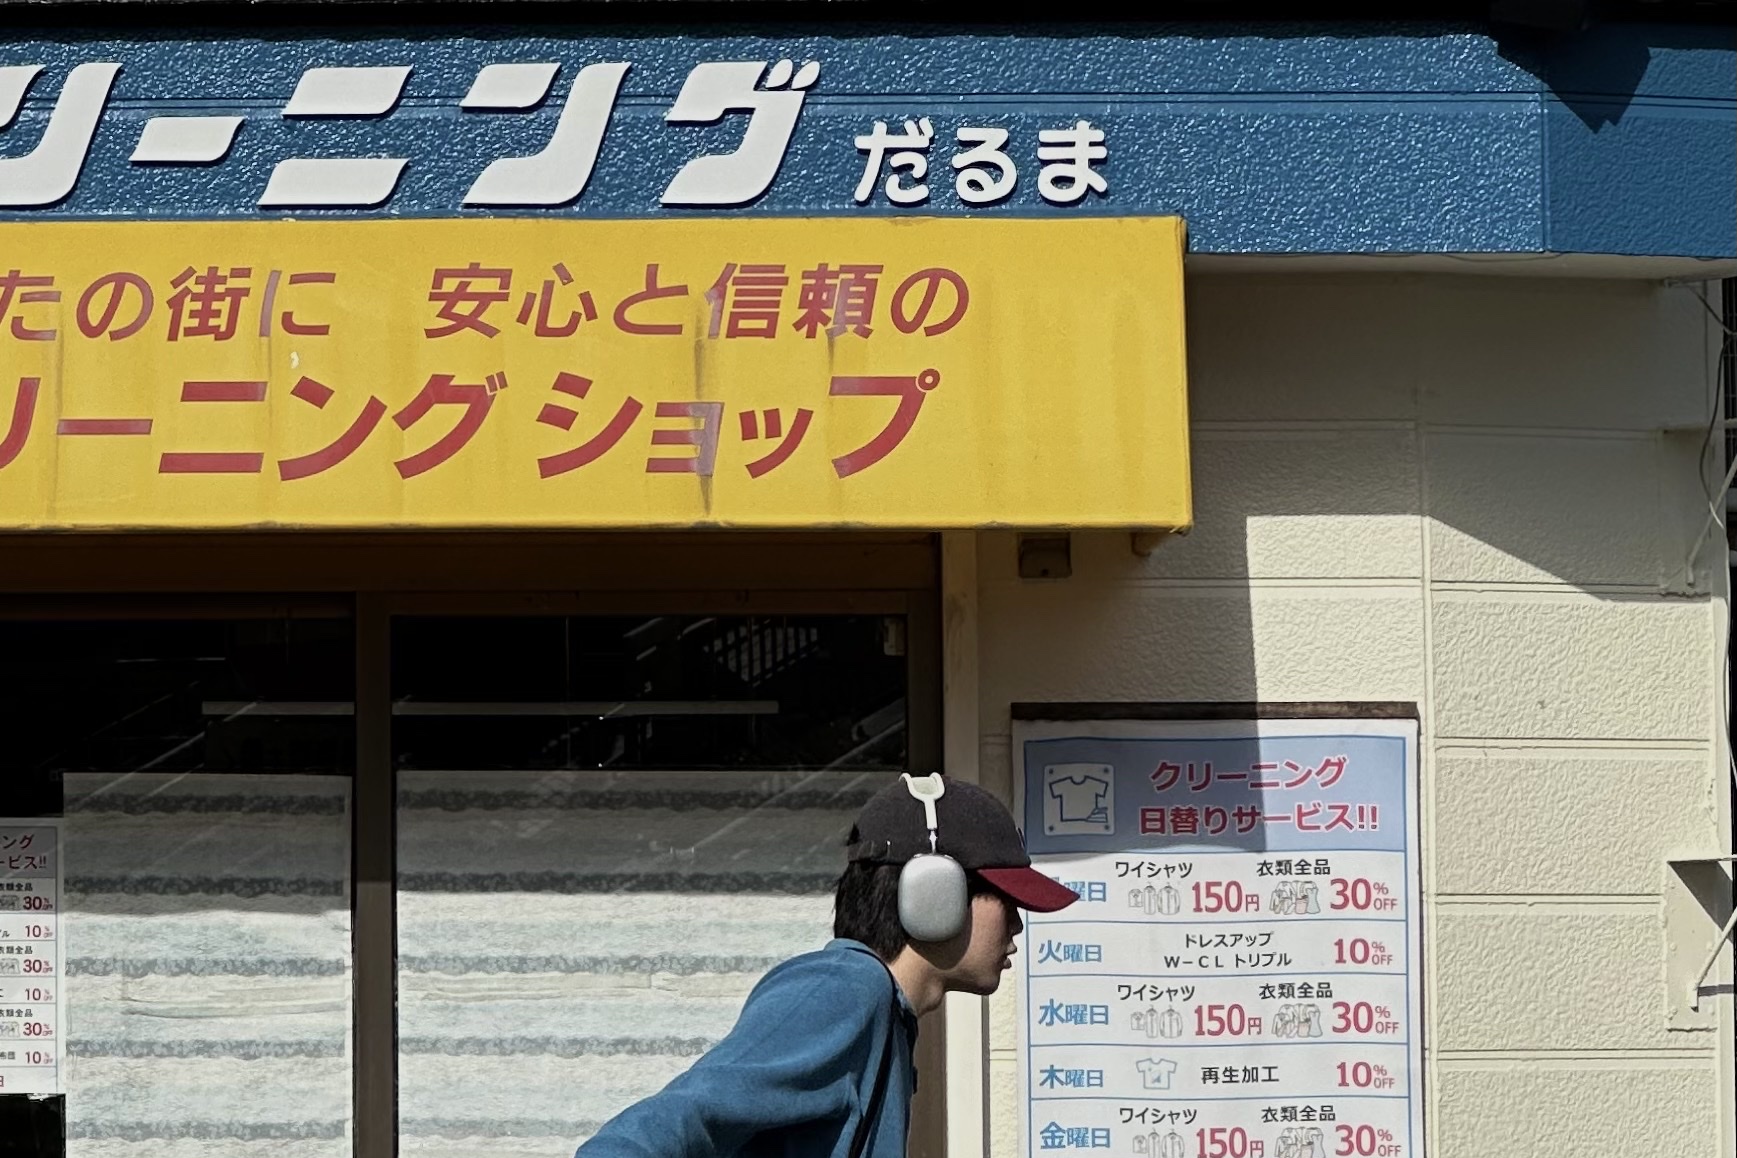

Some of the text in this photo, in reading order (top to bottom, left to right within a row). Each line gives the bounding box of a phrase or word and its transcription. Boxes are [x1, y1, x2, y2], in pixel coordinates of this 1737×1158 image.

[854, 118, 1108, 203] だるま
[0, 262, 970, 342] たの街に 安心と信頼の
[1150, 757, 1348, 793] クリーニング
[1115, 859, 1331, 879] ワイシャツ 衣類全品
[1050, 876, 1107, 903] 曜日
[1191, 881, 1260, 913] 150円
[1037, 940, 1102, 965] 火曜日
[1234, 954, 1292, 969] トリプル
[1184, 932, 1274, 950] ドレスアップ
[1117, 982, 1333, 1001] ワイシャツ 衣類全品
[1038, 1001, 1109, 1027] 水曜日
[1194, 1004, 1262, 1036] 150円
[1038, 1065, 1104, 1089] 木曜日
[1200, 1066, 1279, 1084] 再生加工
[1119, 1105, 1336, 1125] ワイシャツ 衣類全品
[1039, 1121, 1111, 1150] 金曜日
